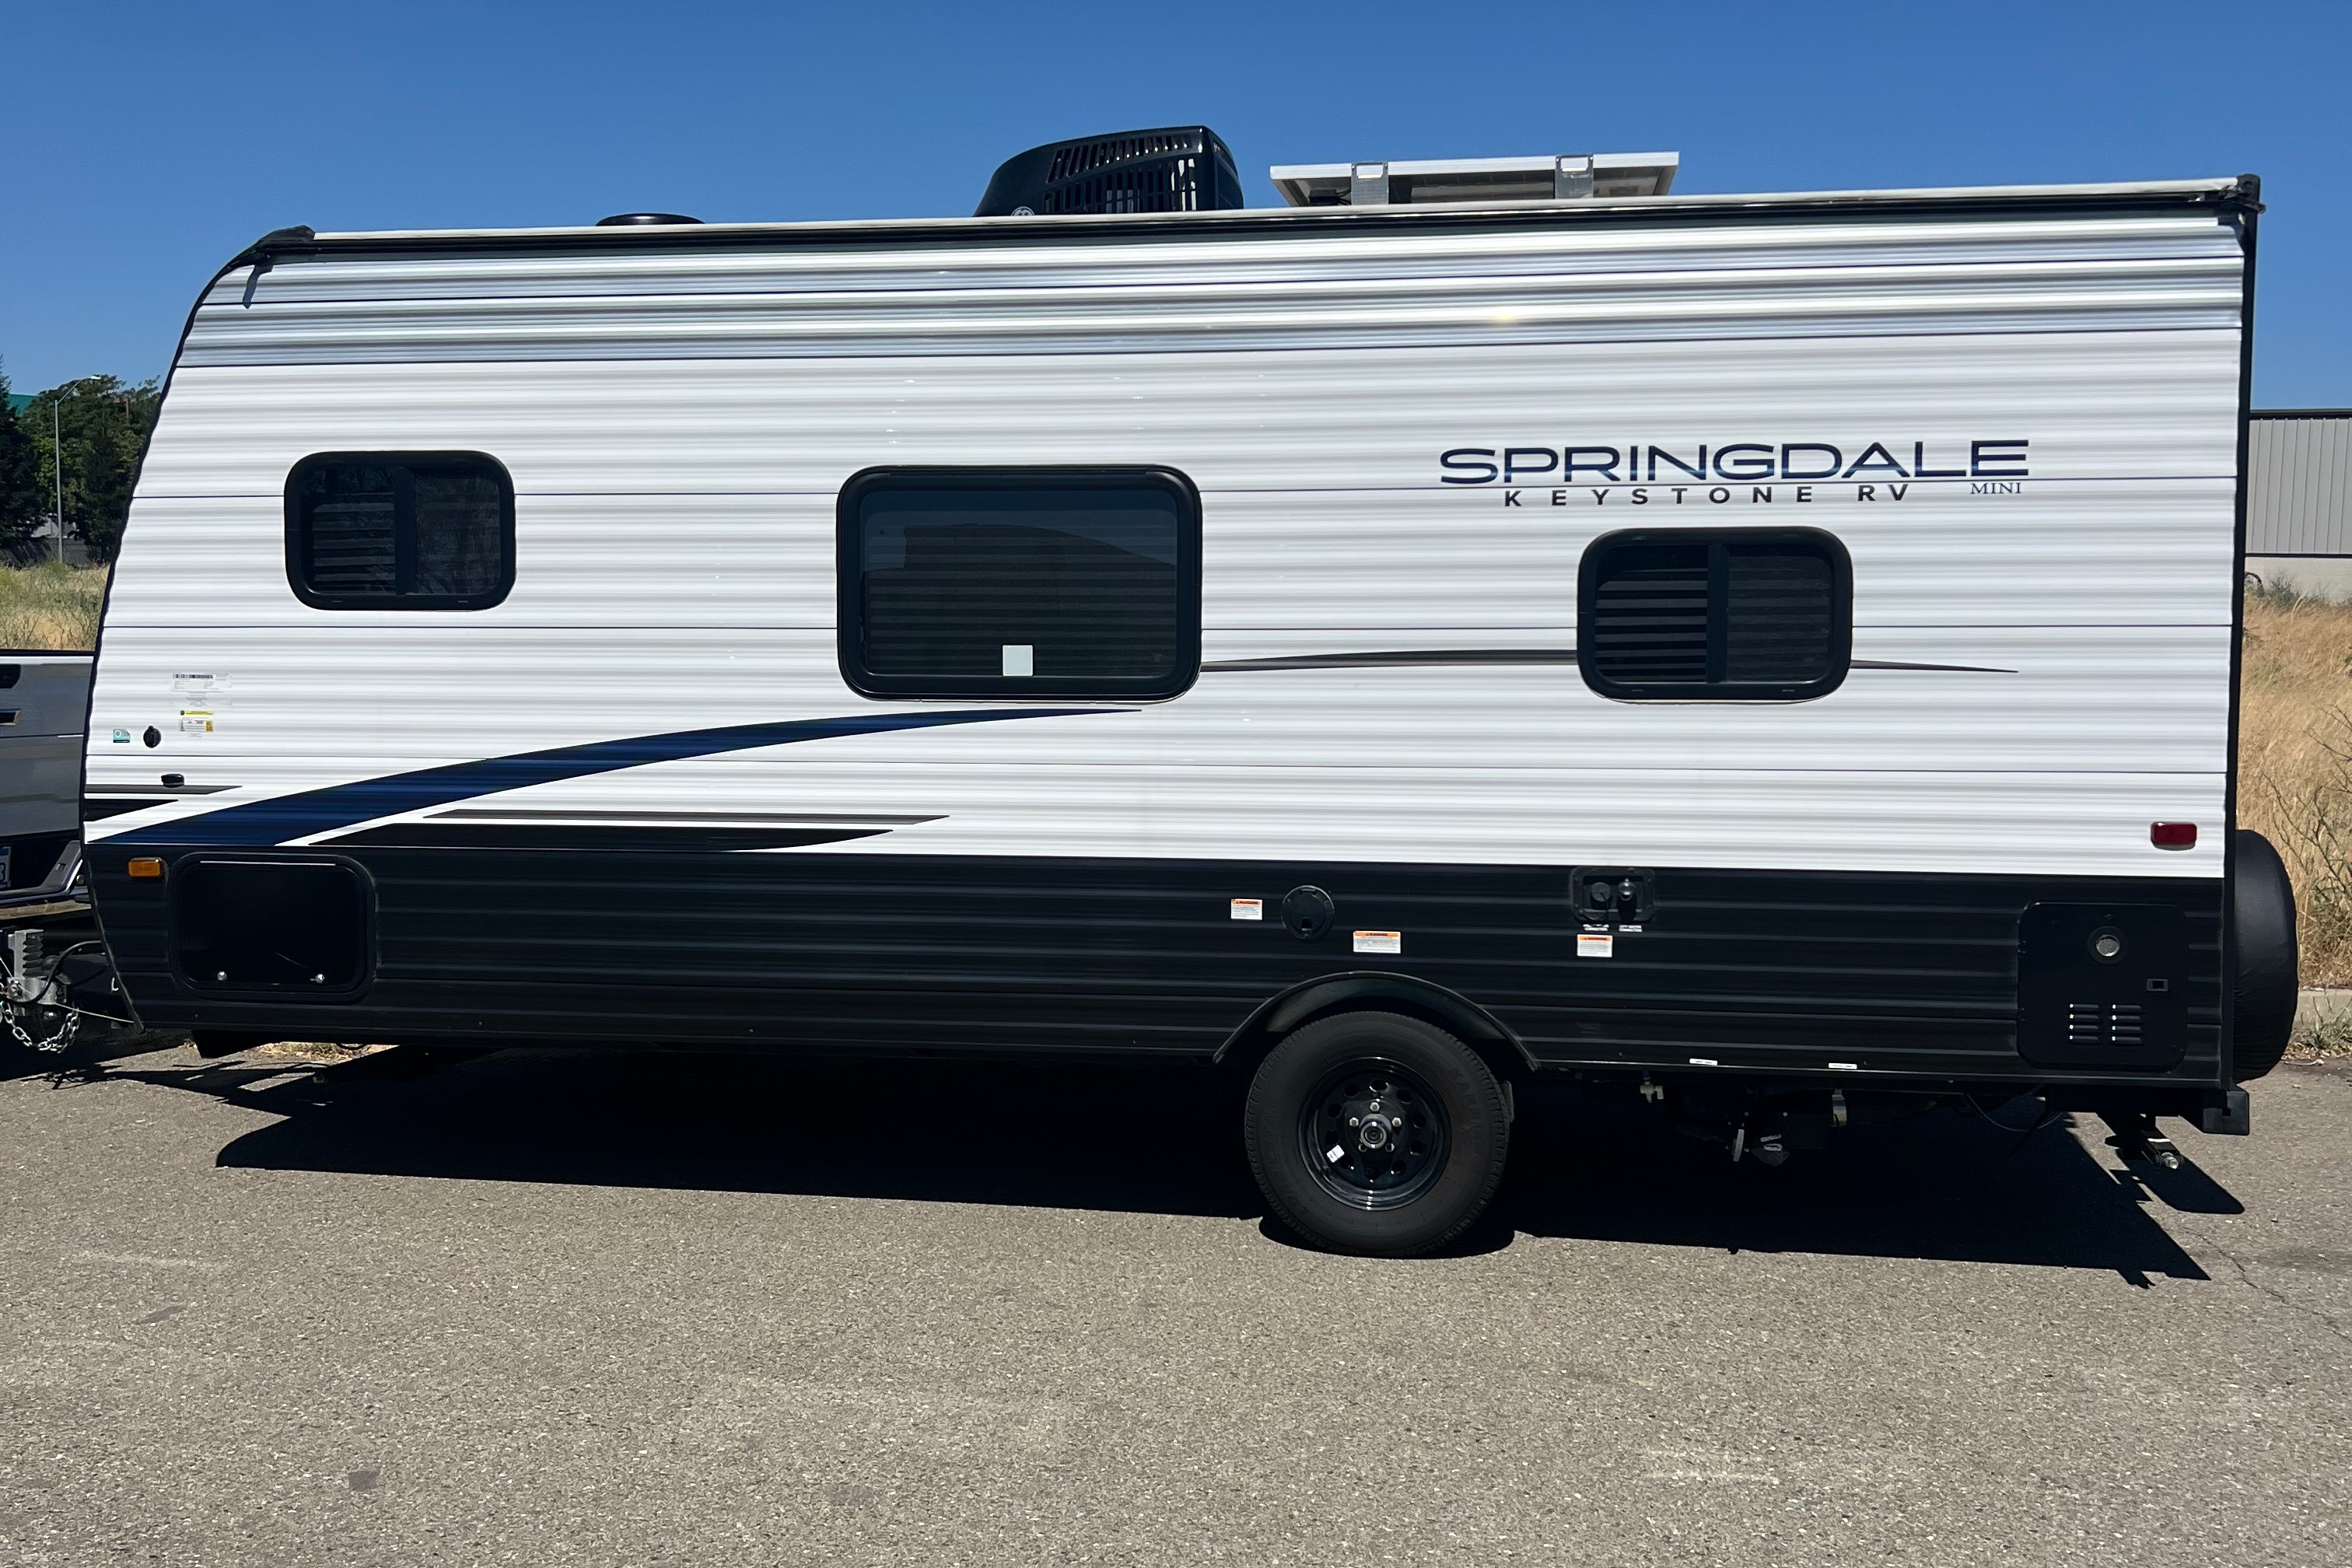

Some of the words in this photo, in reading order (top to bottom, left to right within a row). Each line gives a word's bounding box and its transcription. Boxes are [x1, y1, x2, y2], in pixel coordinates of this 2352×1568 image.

[1440, 439, 2029, 485] SPRINGDALE
[1504, 485, 1812, 507] KEYSTONE
[1857, 484, 1909, 502] RV
[1969, 482, 2021, 495] MINI
